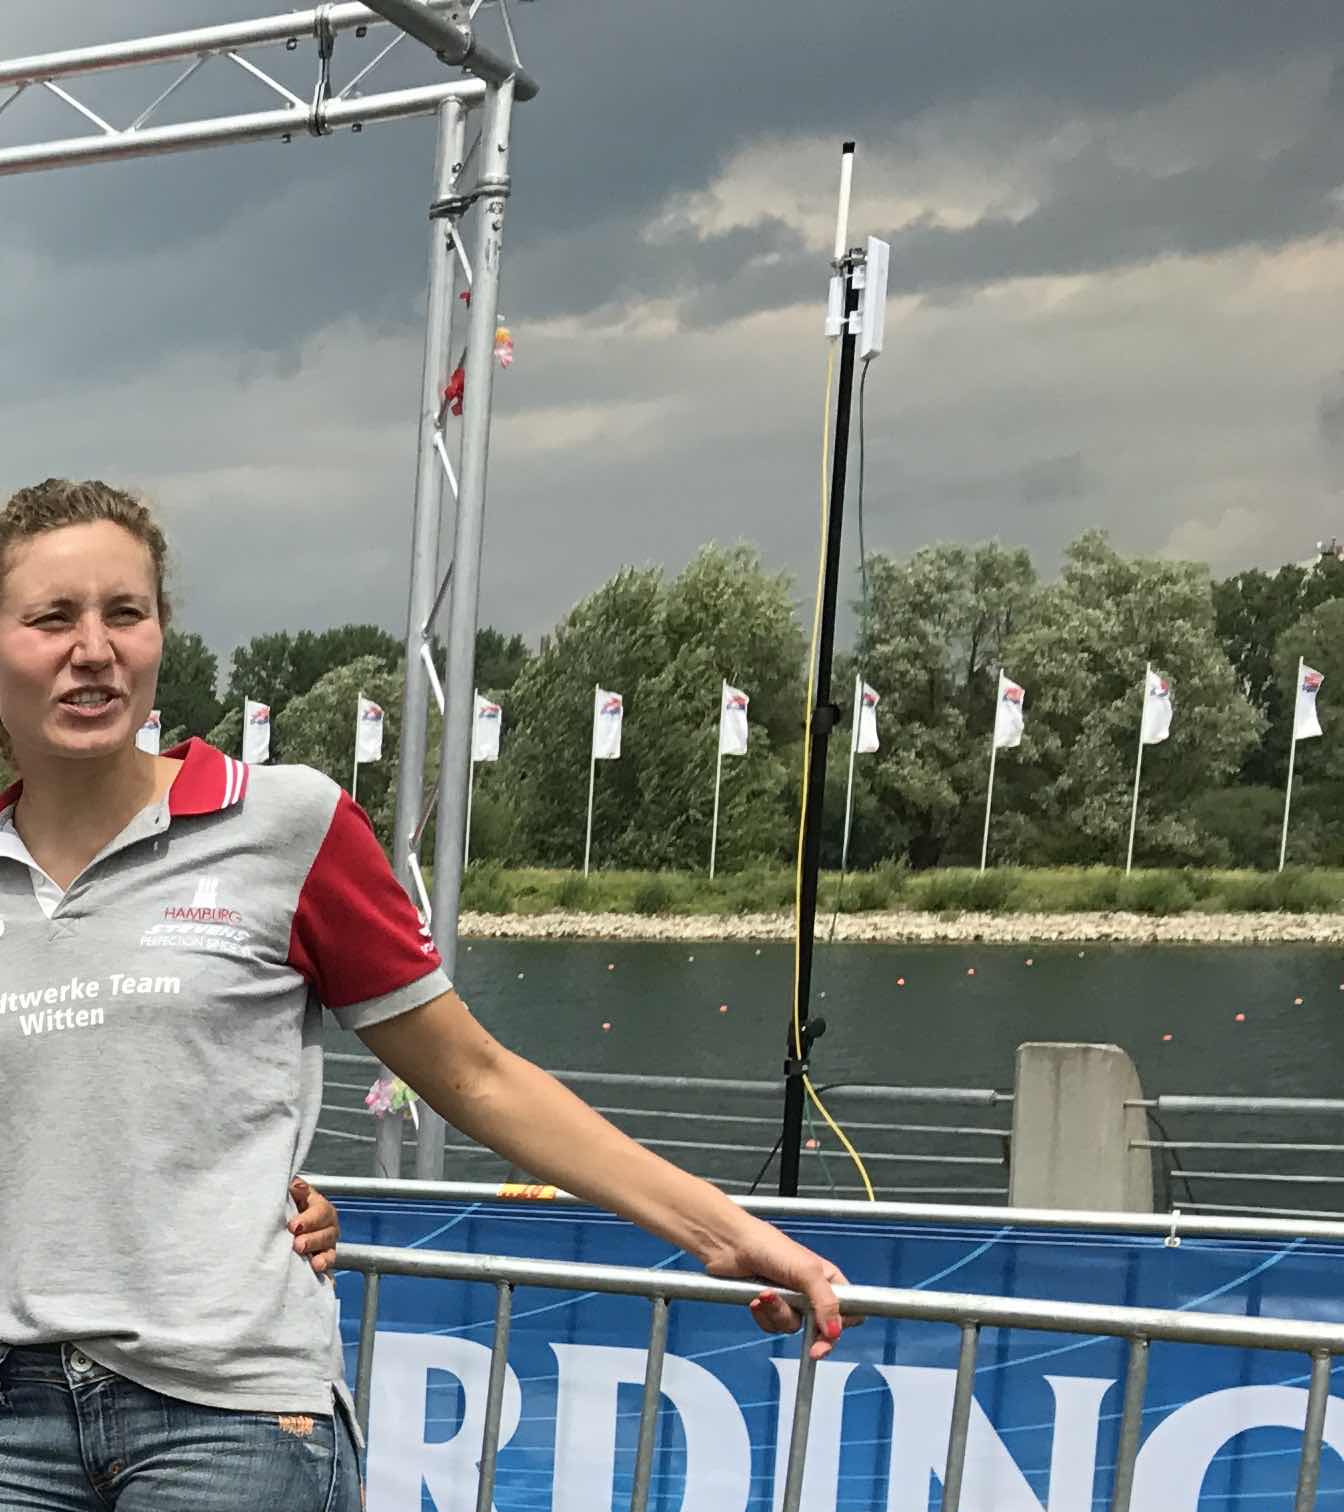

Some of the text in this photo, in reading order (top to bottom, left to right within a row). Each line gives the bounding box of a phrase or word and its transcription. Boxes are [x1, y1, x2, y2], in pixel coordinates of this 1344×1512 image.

[163, 905, 242, 924] HAMBURG
[109, 973, 181, 996] Team
[19, 1007, 105, 1037] Witten
